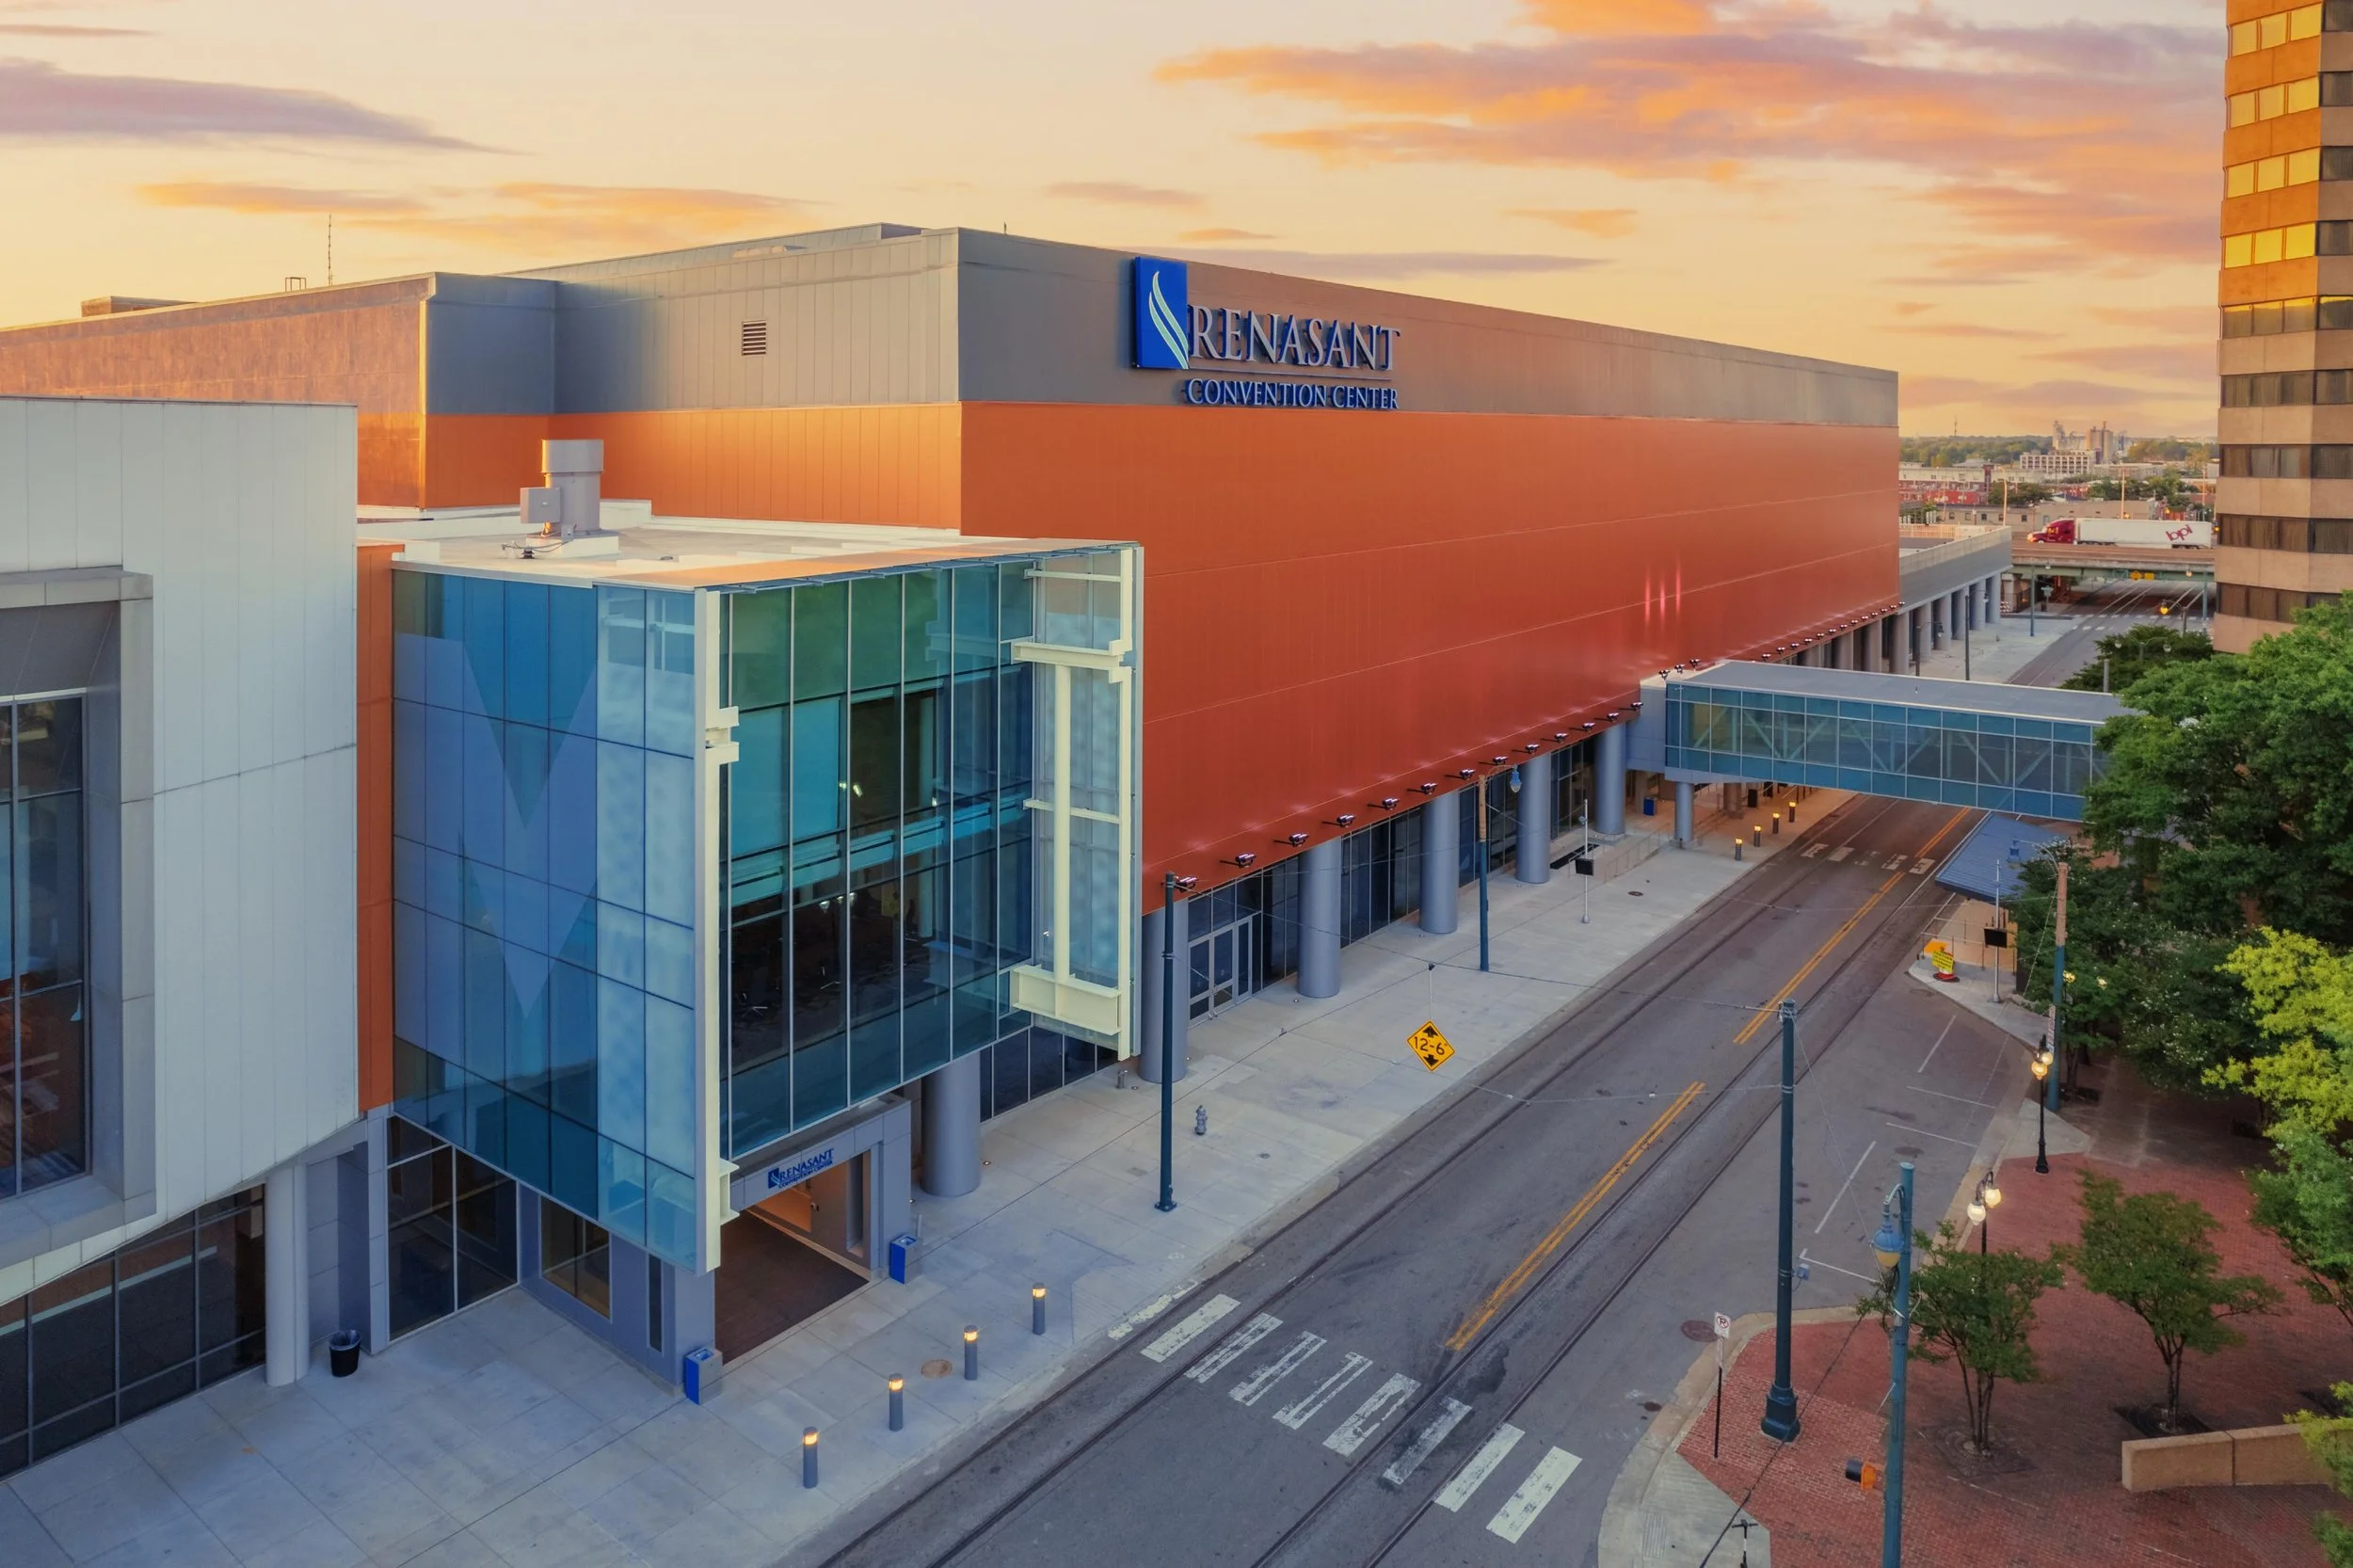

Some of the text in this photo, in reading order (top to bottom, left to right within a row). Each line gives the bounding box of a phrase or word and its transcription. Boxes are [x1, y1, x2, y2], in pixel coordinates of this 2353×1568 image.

[1188, 304, 1401, 371] RENASANT
[1184, 378, 1400, 409] CONVENTION CENTER
[2165, 524, 2193, 542] bpi
[779, 1147, 834, 1181] RENASANT
